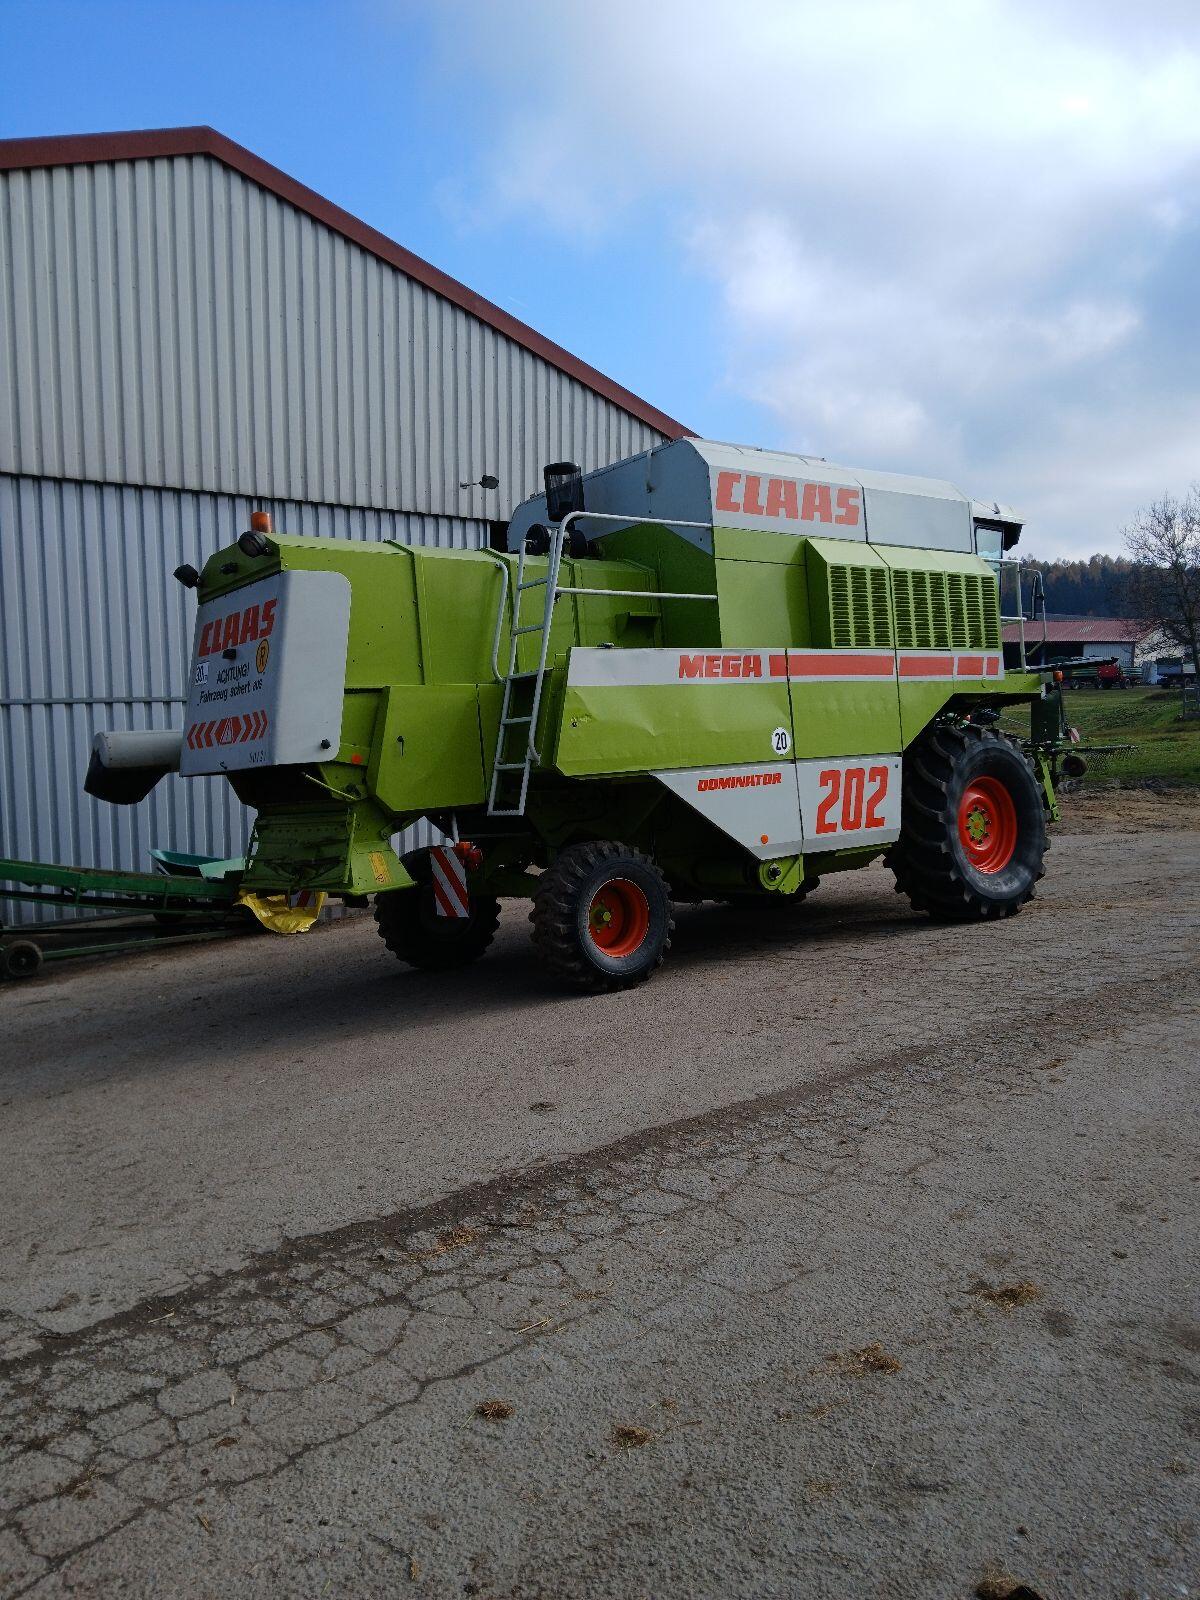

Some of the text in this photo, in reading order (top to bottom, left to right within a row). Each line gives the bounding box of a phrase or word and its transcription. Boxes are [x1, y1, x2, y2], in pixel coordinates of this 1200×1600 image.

[715, 471, 860, 525] CLAAS
[198, 599, 278, 657] CLAAS
[216, 662, 250, 685] ACHTUNG!
[678, 654, 762, 679] MEGA
[199, 689, 229, 704] Fahrzeug
[229, 681, 251, 698] schert
[774, 732, 787, 750] 20
[697, 772, 782, 792] DOMINATOR
[815, 766, 889, 835] 202
